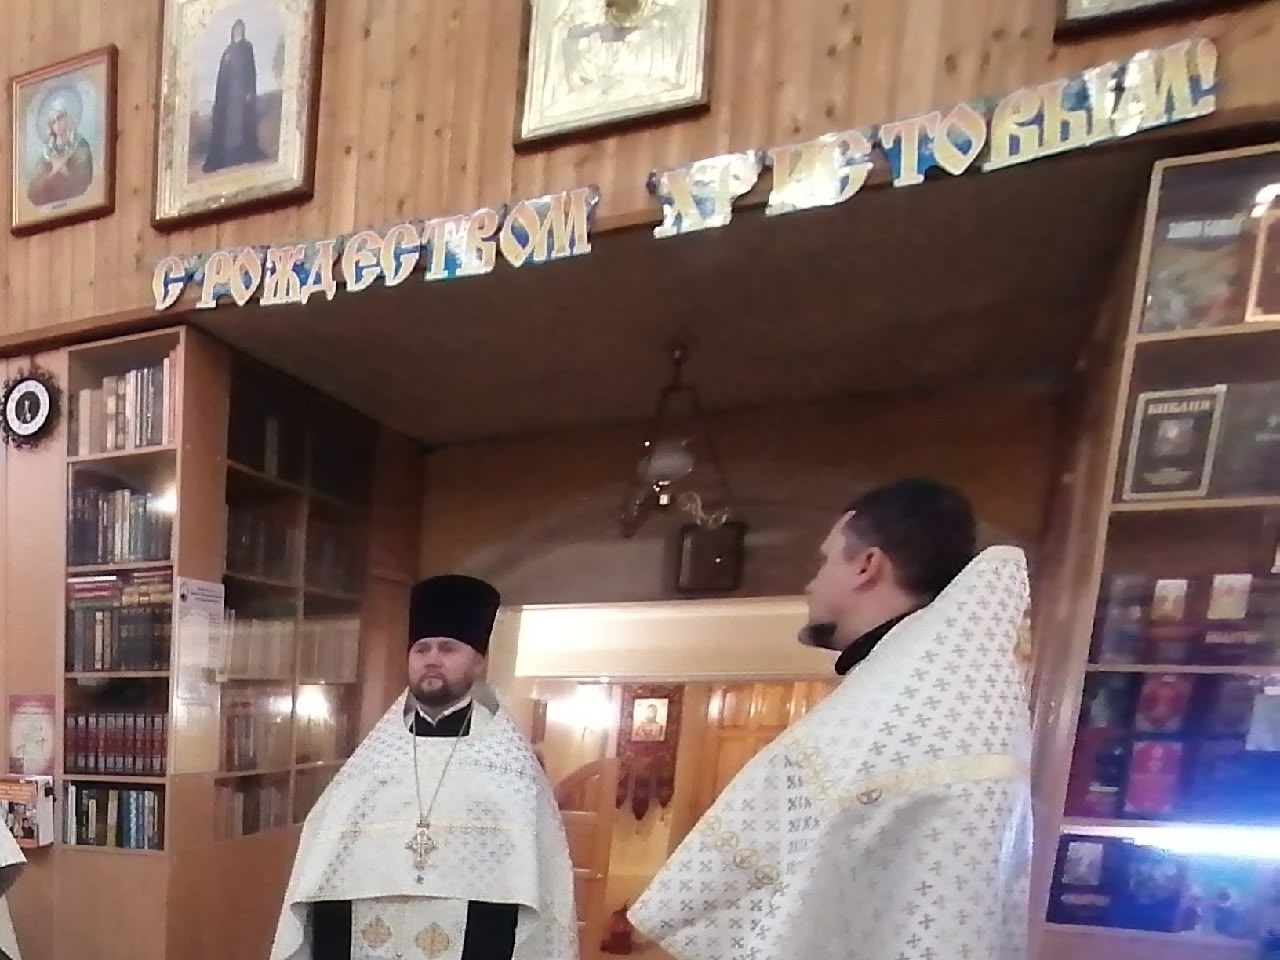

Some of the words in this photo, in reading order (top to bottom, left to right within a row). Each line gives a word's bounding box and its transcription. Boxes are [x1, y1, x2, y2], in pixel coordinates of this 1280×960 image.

[152, 257, 186, 311] С
[195, 187, 599, 309] РОЖДЕСТВОМ
[652, 37, 1219, 239] ХРИСТОВЫМ!
